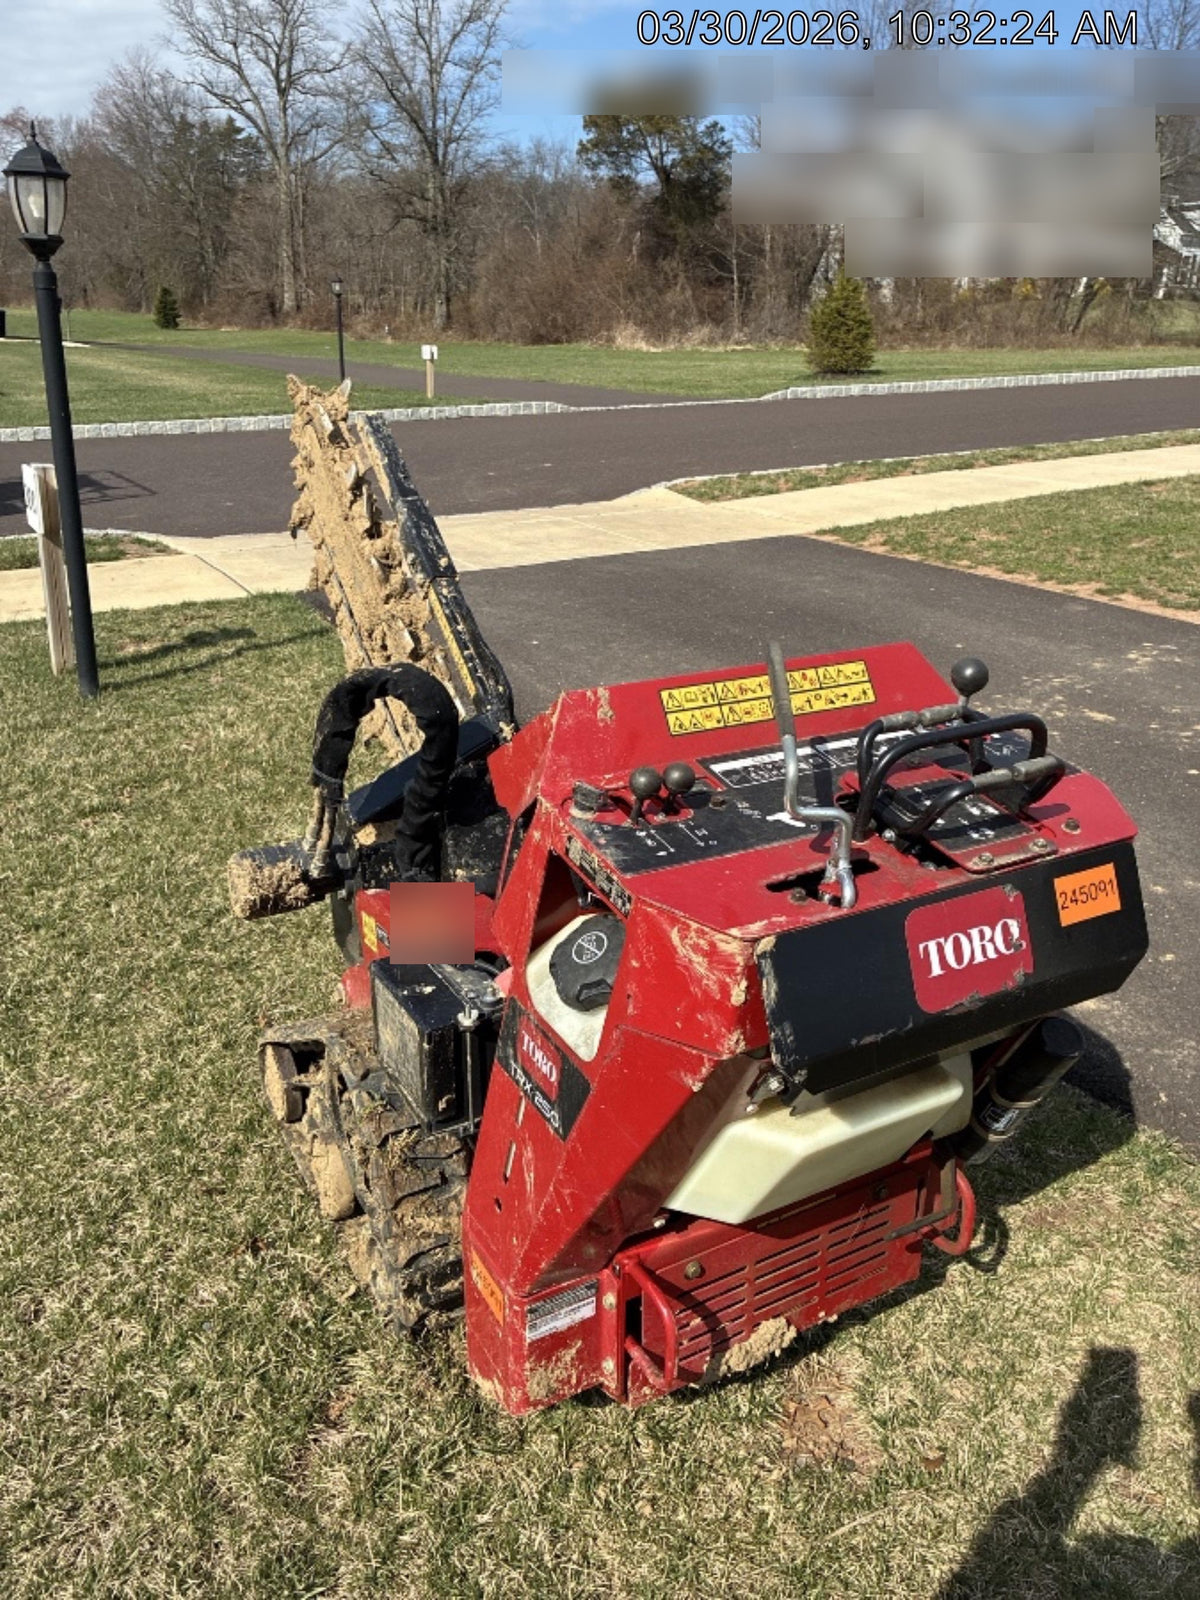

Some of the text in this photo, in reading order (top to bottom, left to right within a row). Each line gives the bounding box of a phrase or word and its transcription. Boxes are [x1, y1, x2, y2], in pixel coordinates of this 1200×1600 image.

[1059, 877, 1116, 911] 245091
[918, 917, 1023, 979] TORO
[521, 1030, 558, 1083] TORO
